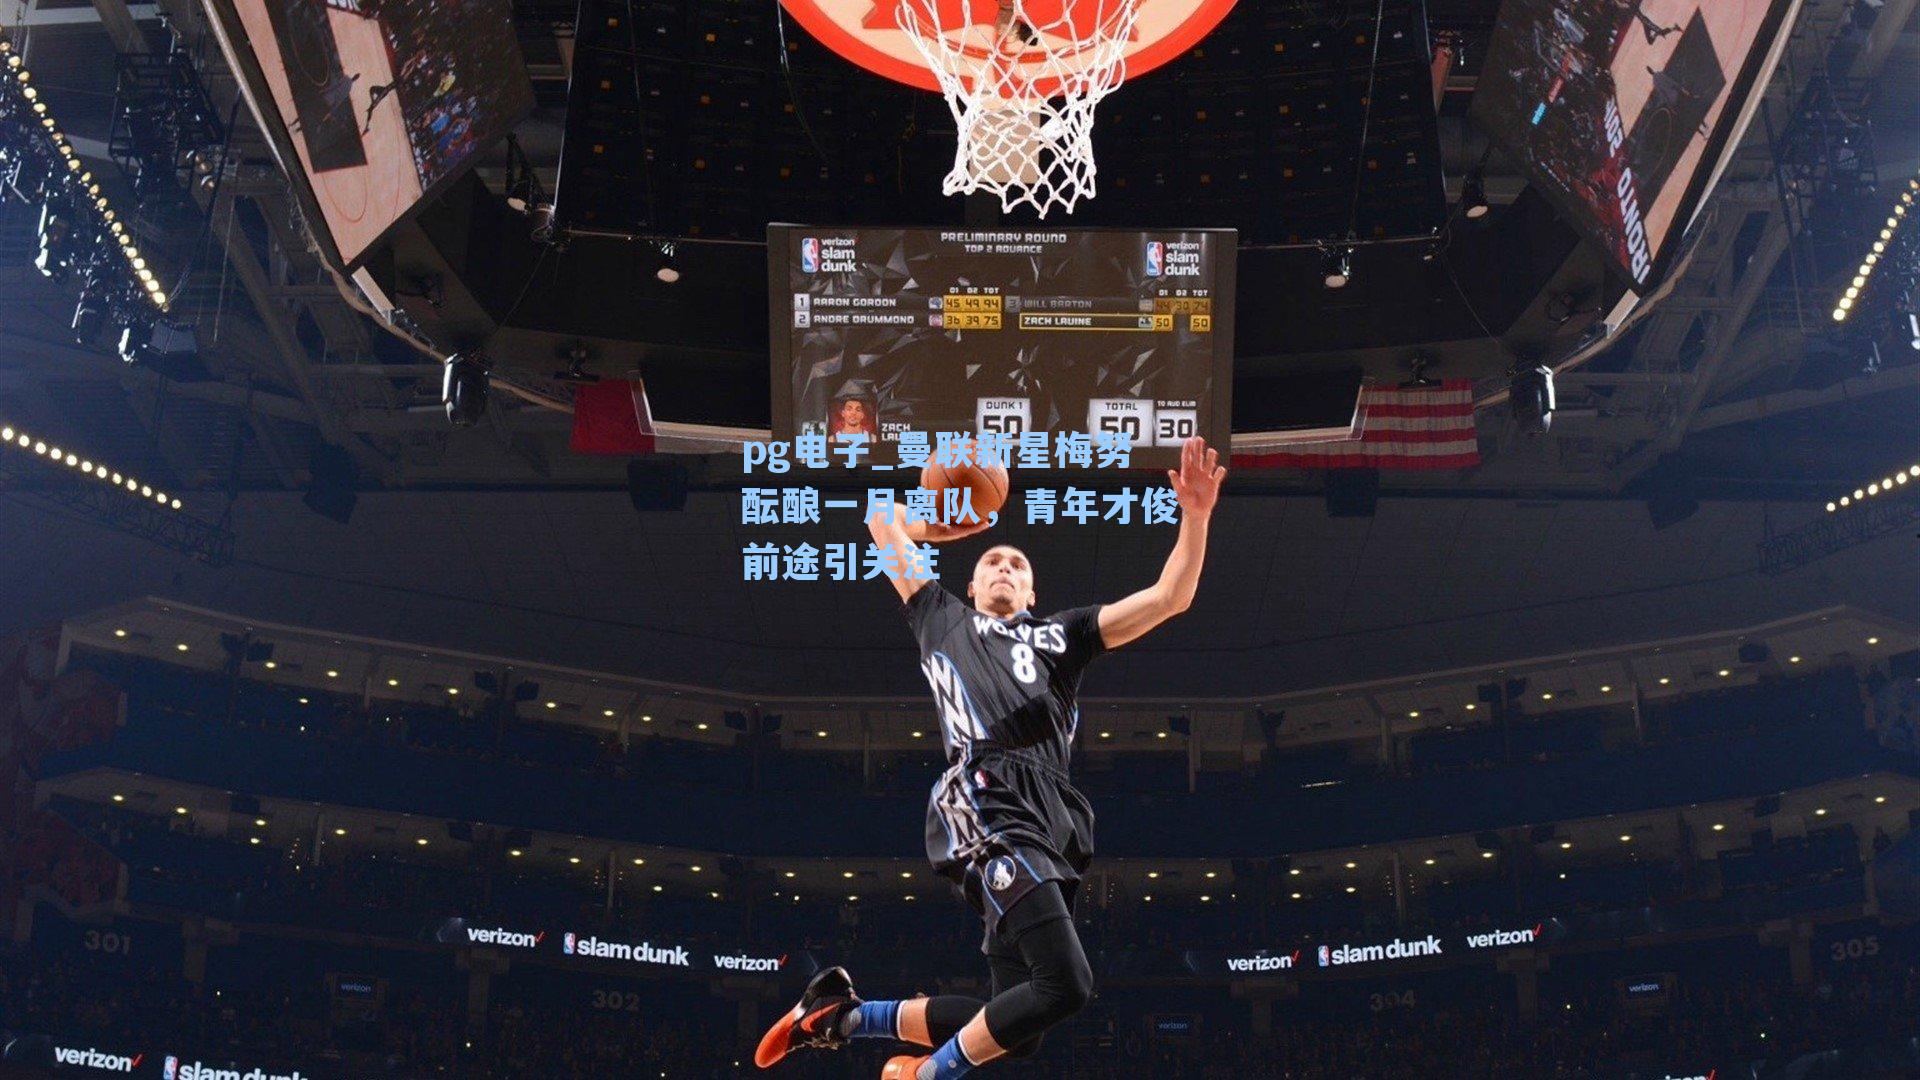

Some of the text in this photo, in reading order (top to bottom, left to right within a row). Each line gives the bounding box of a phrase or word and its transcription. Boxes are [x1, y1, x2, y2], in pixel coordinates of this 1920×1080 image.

[821, 238, 854, 246] verizon
[941, 232, 1067, 243] PRELIMINARY ROUND
[821, 247, 855, 259] slam
[965, 244, 984, 253] TOP
[987, 245, 993, 253] 2
[1165, 251, 1200, 263] slam
[821, 261, 856, 272] dunk
[1165, 264, 1200, 276] dunk
[983, 286, 999, 294] TOT
[813, 298, 849, 307] AARON
[853, 298, 896, 307] GORDON
[946, 299, 960, 308] 45
[965, 299, 980, 308] 49
[983, 299, 999, 308] 94
[1024, 299, 1048, 308] WILL
[1050, 300, 1092, 309] BARTON
[798, 314, 806, 324] 2
[813, 315, 849, 324] ANDRE
[852, 315, 914, 324] DRUMMOND
[966, 316, 980, 325] 39
[984, 316, 999, 325] 75
[1024, 317, 1052, 325] ZACH
[1156, 318, 1170, 327] 50
[1193, 318, 1208, 327] 50
[985, 401, 1014, 409] DUNK
[1106, 402, 1138, 410] TOTAL
[881, 423, 910, 432] ZACH
[983, 415, 1022, 439] 50
[1100, 416, 1140, 441] 50
[1160, 418, 1193, 438] 30
[1011, 643, 1037, 684] 8
[85, 930, 132, 955] 301
[467, 928, 535, 947] verizon
[1466, 929, 1534, 949] verizon
[577, 937, 689, 967] slam dunk
[1331, 934, 1442, 965] slam dunk
[1830, 935, 1879, 961] 305
[714, 954, 779, 971] verizon
[1227, 954, 1292, 972] verizon
[591, 990, 640, 1011] 302
[55, 1046, 133, 1072] verizon
